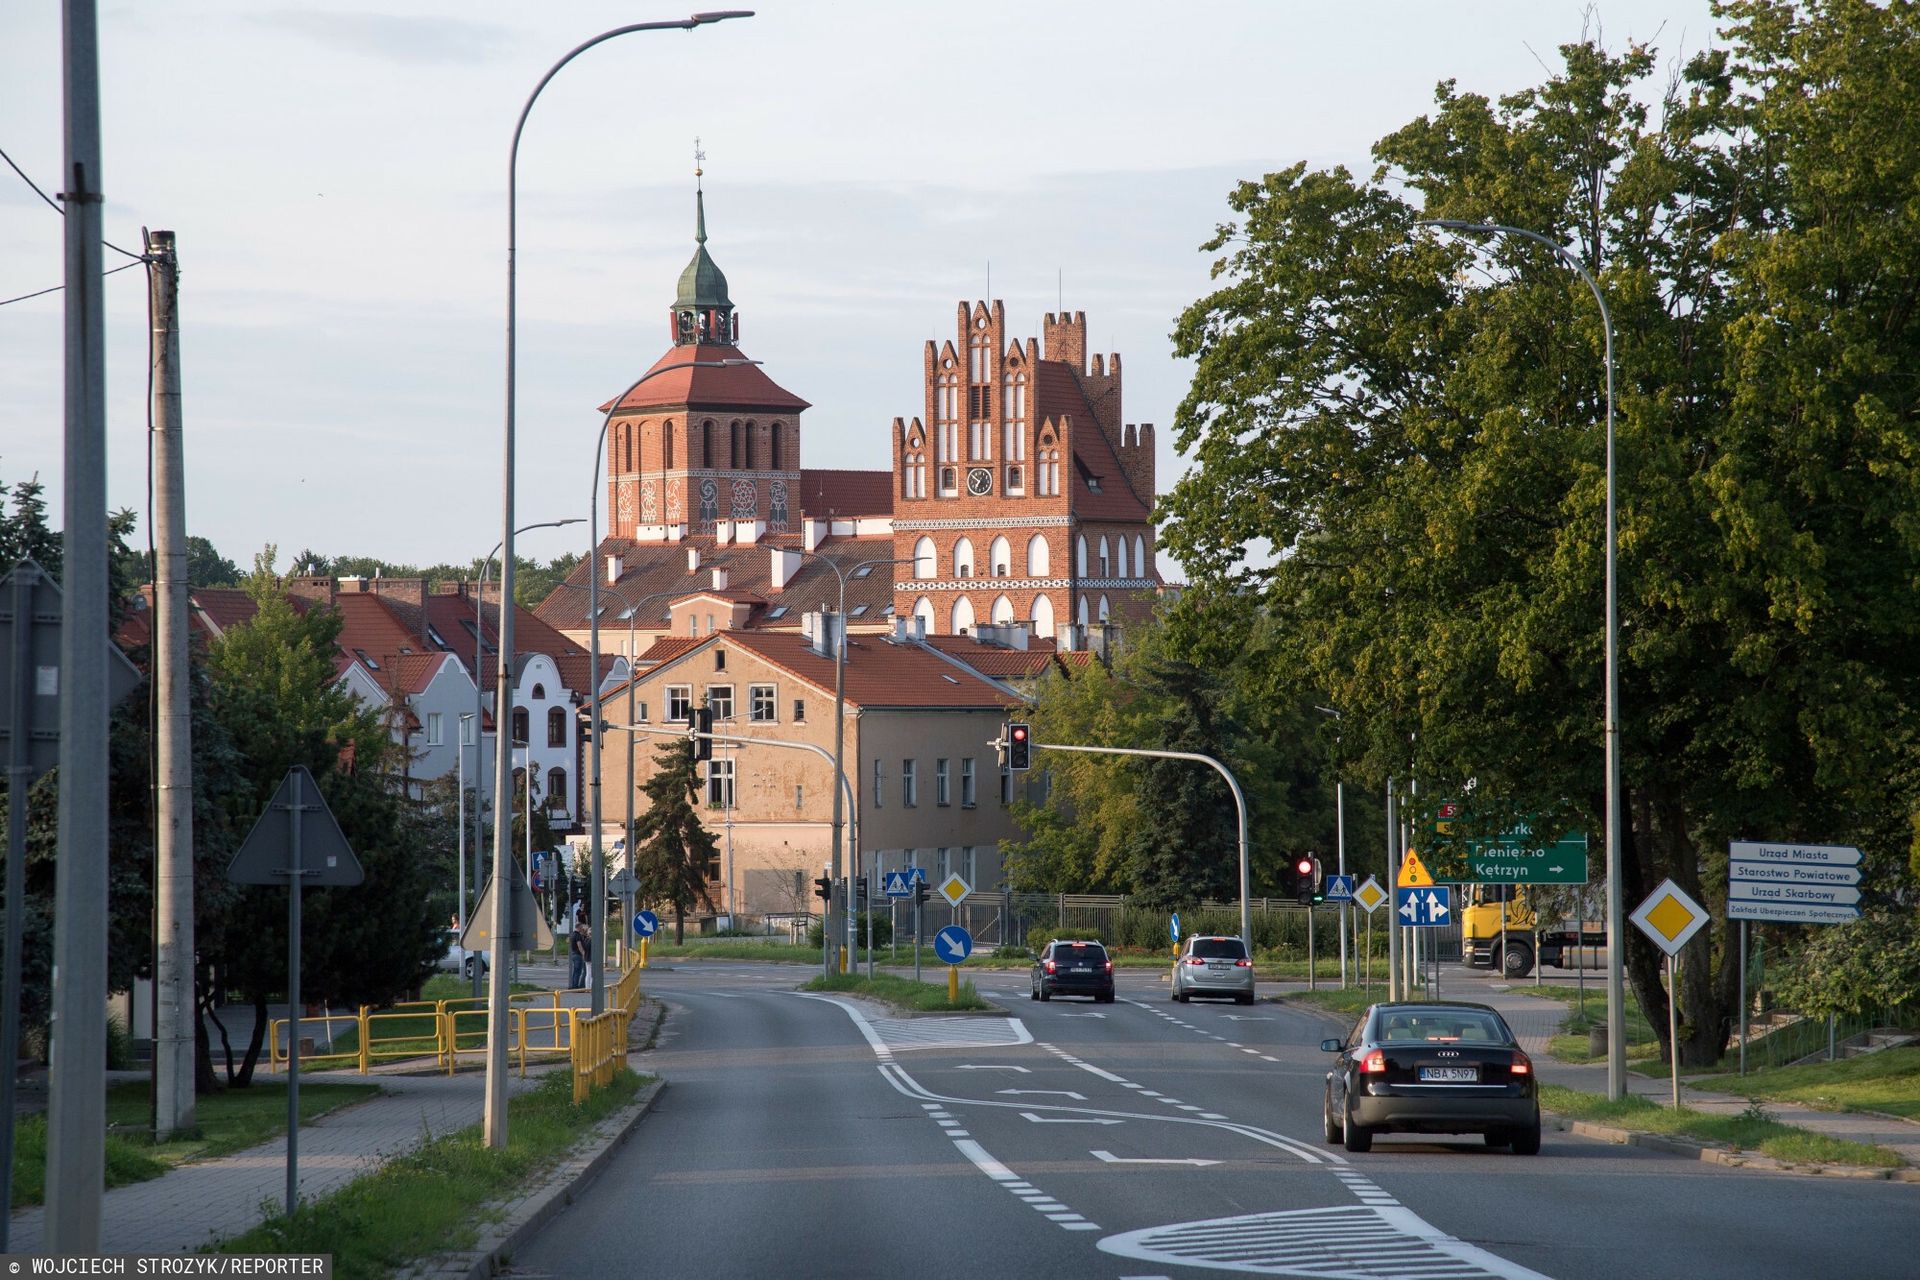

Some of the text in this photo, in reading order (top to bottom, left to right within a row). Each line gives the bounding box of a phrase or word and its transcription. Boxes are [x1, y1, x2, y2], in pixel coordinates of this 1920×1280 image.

[1792, 850, 1828, 860] Miasta
[1476, 864, 1528, 879] Kętrzyn
[1738, 867, 1851, 881] Starostwo Powiatowe
[1785, 889, 1835, 901] Skarbowy
[1427, 1069, 1448, 1079] NBA
